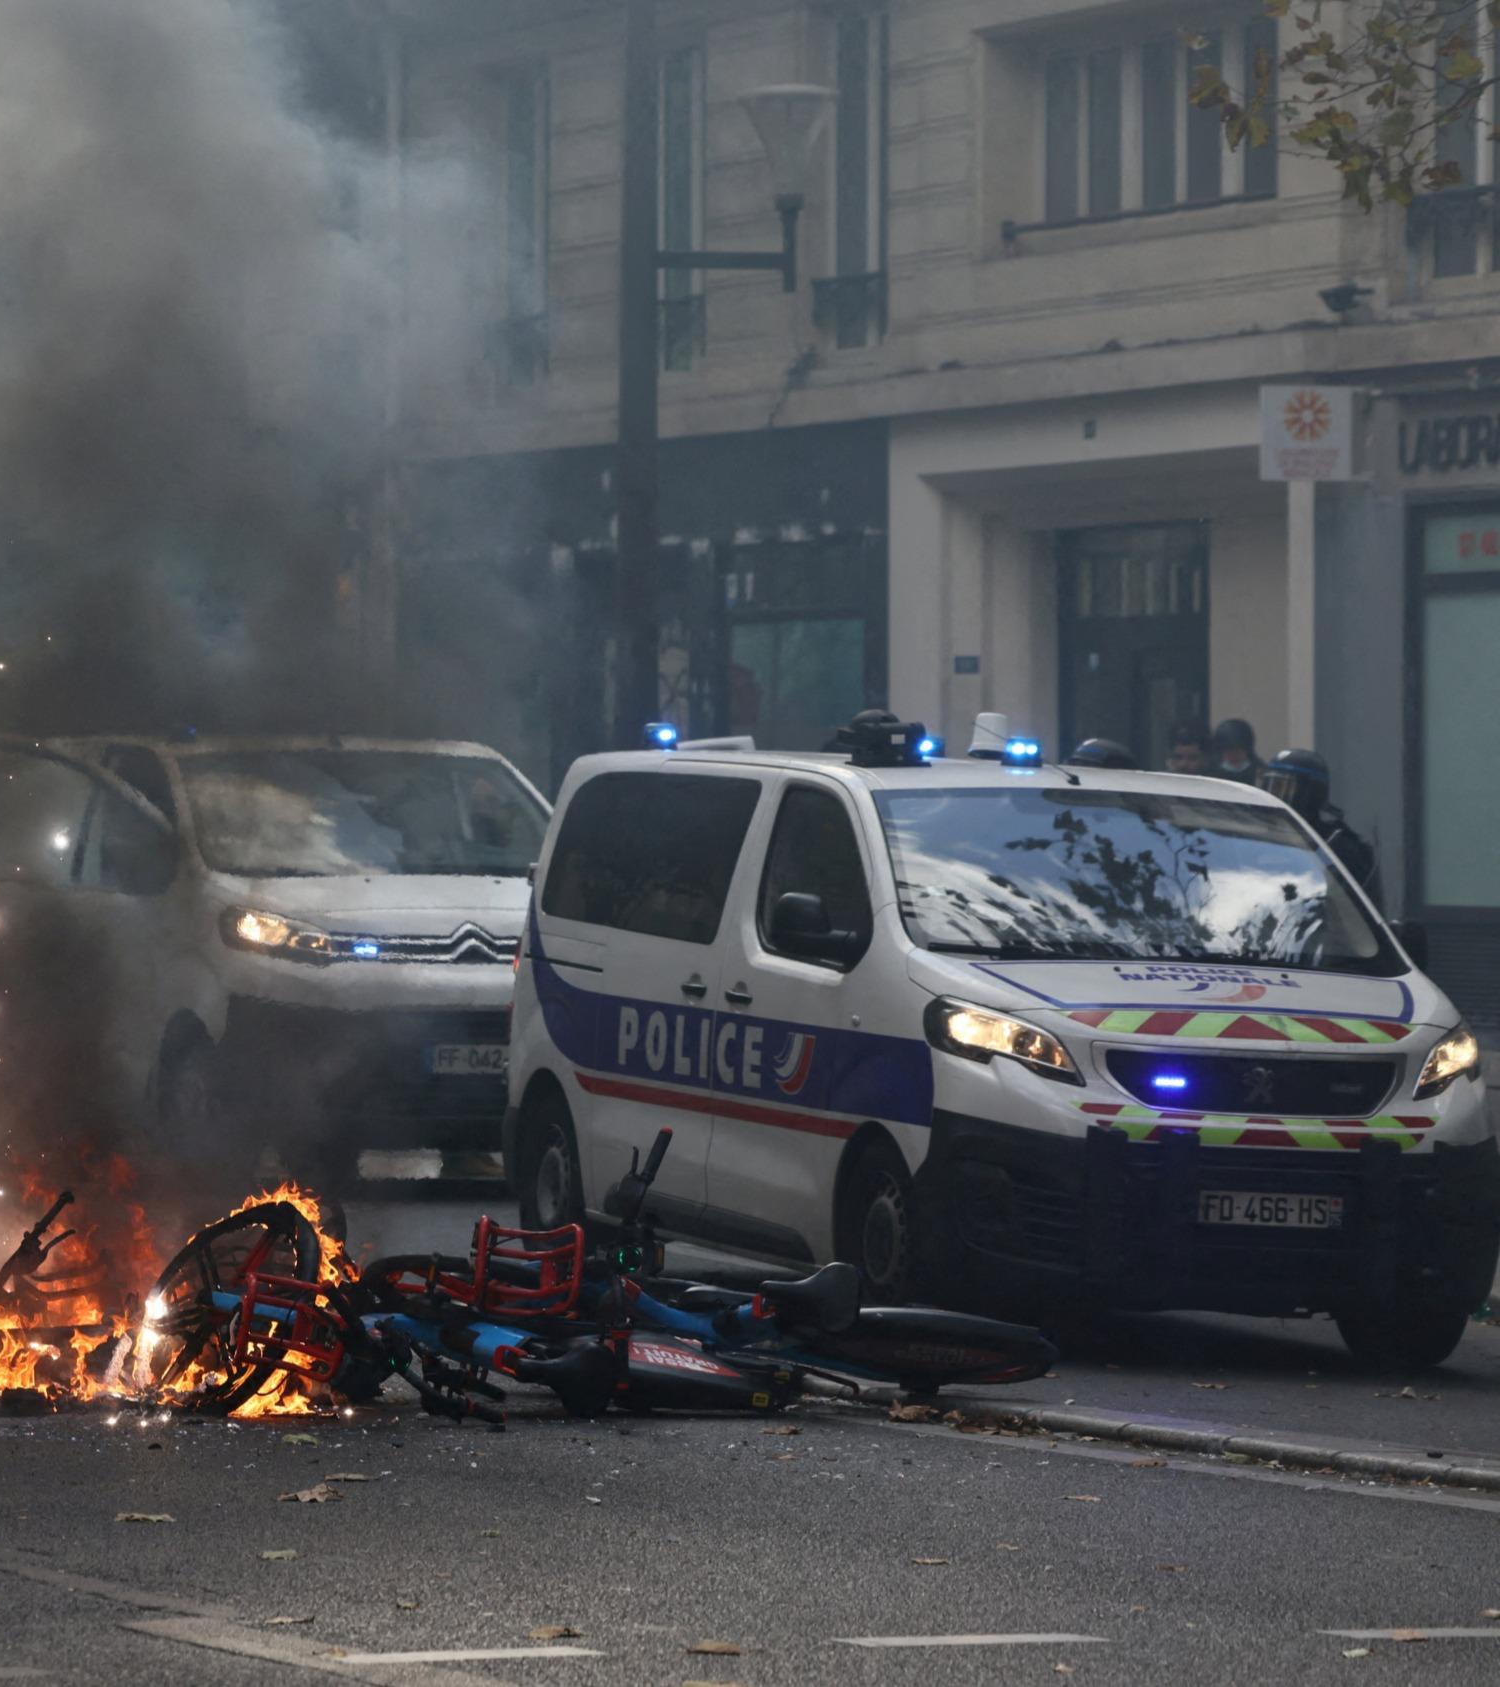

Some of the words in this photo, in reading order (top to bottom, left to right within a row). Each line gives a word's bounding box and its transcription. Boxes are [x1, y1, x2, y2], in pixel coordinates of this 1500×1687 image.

[1145, 966, 1254, 977] POLICE
[1119, 973, 1302, 988] NATIONALE
[618, 1006, 764, 1089] POLICE
